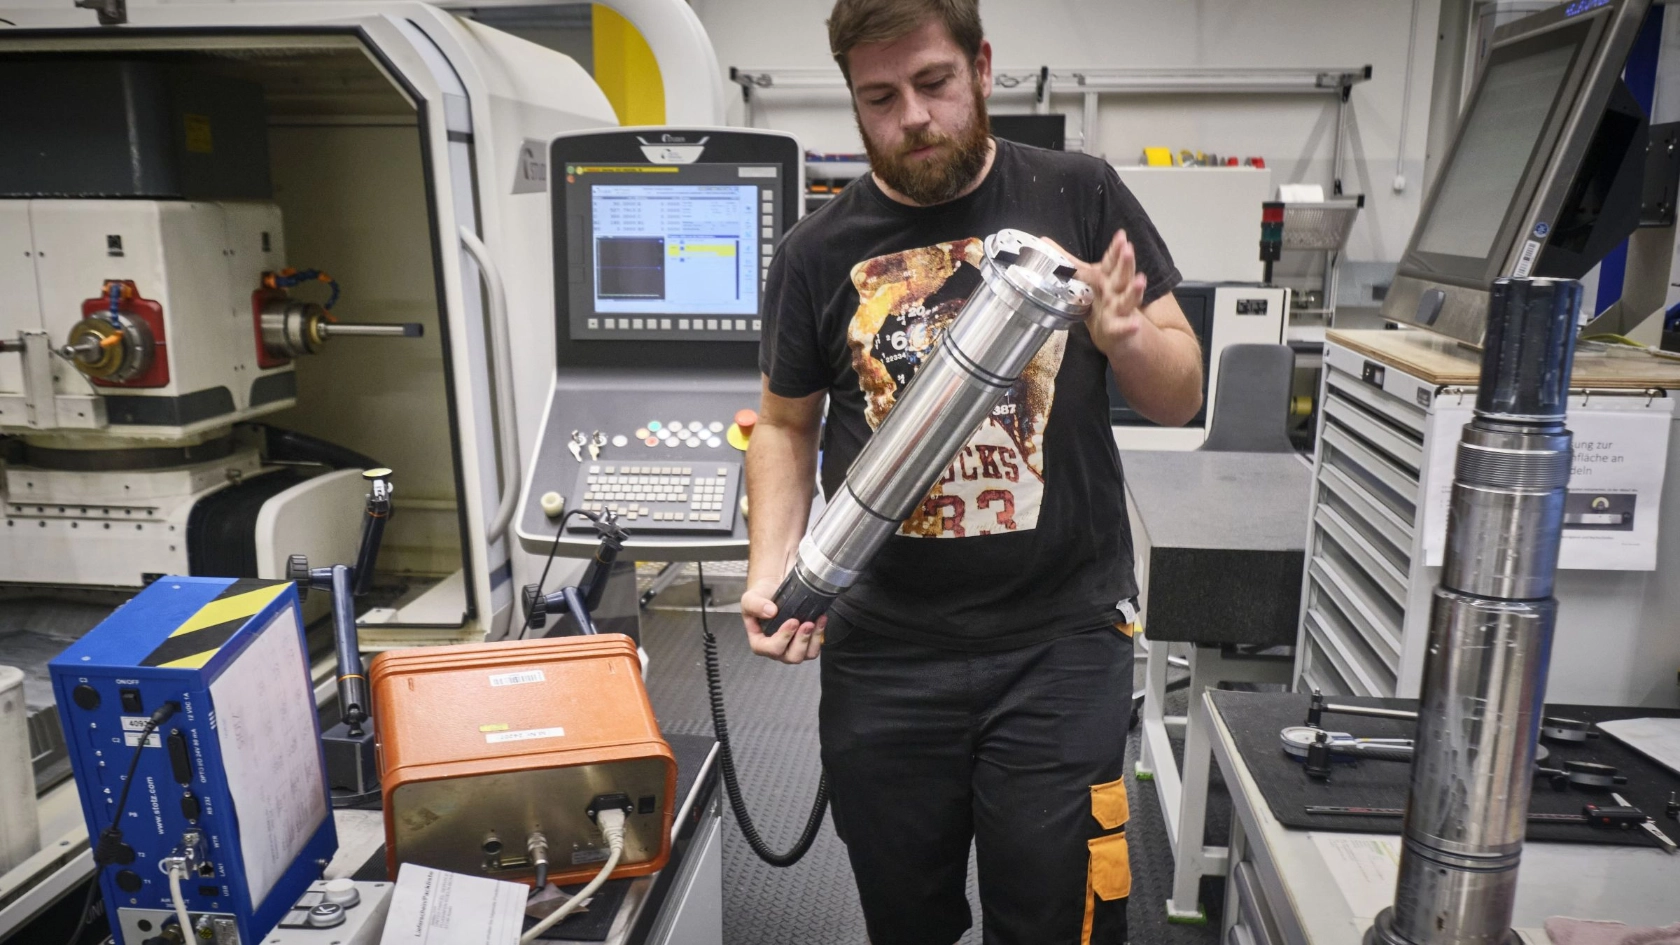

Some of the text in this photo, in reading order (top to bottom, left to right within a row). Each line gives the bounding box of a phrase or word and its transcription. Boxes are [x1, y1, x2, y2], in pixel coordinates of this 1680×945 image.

[1596, 441, 1613, 450] zur
[1610, 455, 1625, 463] an
[146, 776, 165, 835] www.stotz.com
